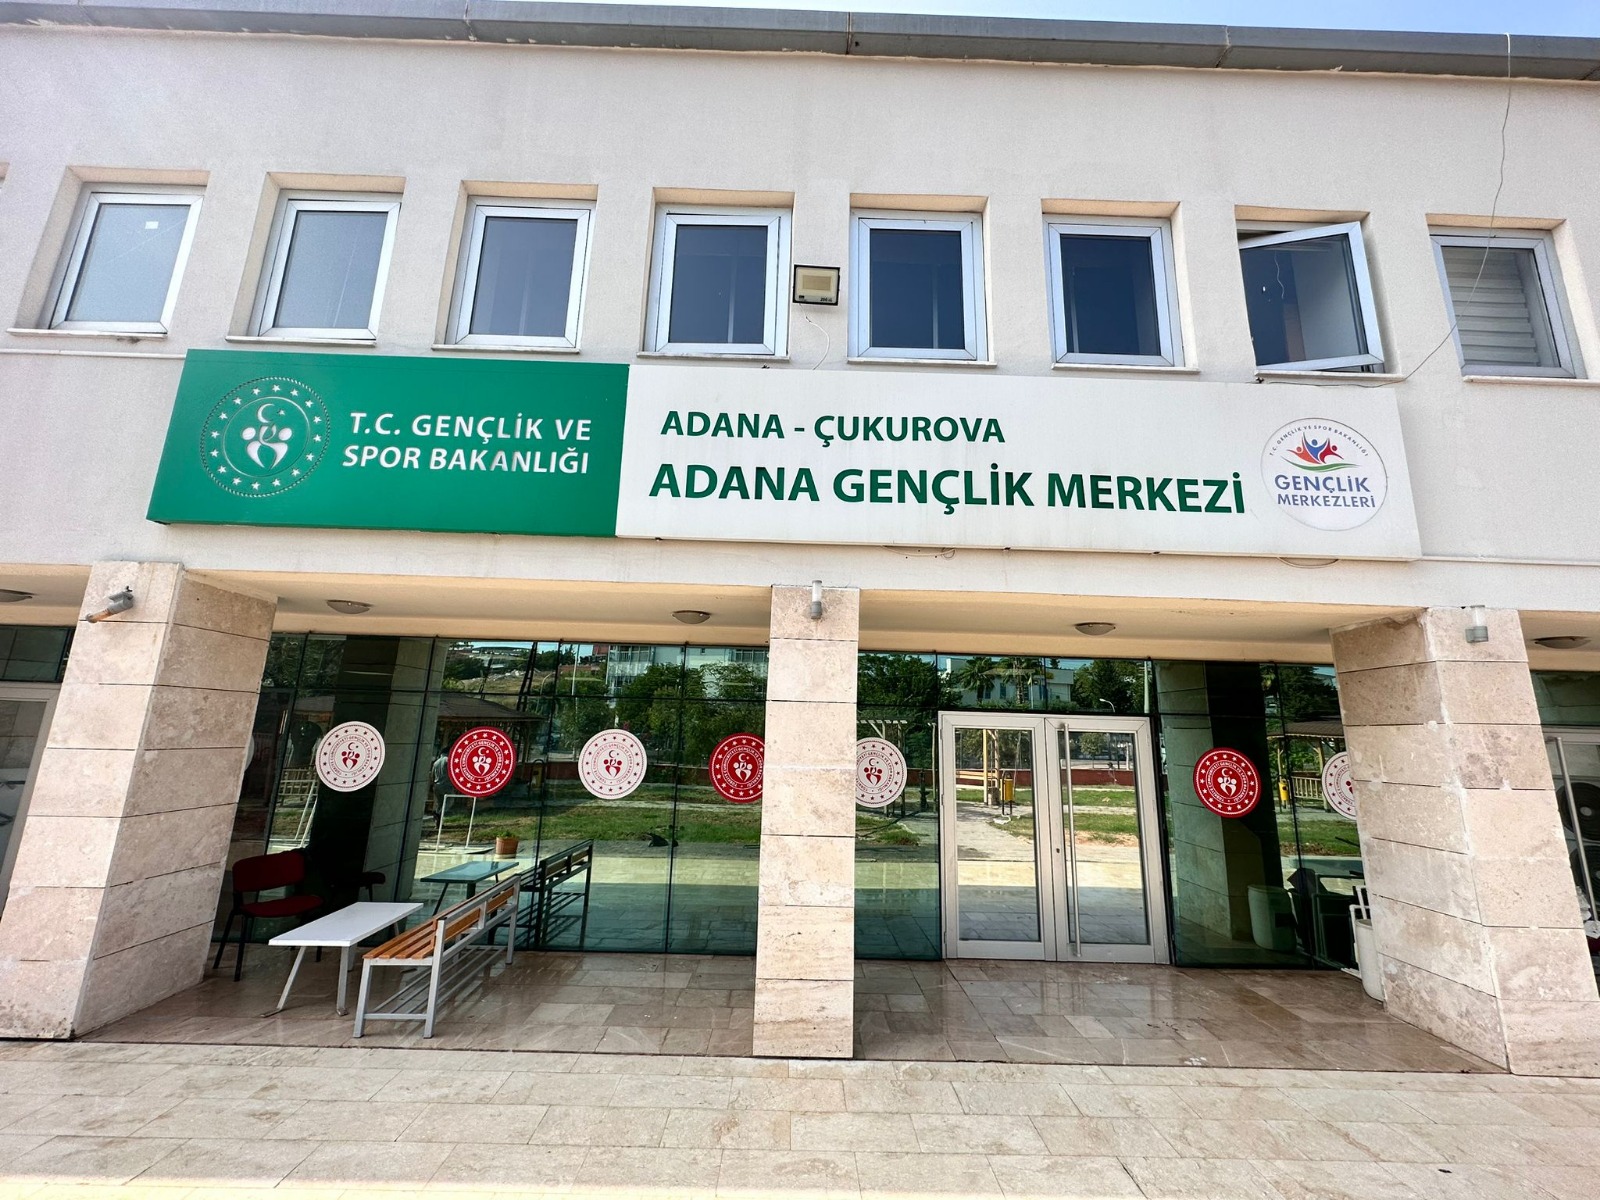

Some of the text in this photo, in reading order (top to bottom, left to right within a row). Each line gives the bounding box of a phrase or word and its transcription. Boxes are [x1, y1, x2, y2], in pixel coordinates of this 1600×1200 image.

[350, 412, 592, 444] T.C. GENÇLİK VE
[660, 410, 785, 439] ADANA
[813, 415, 1006, 448] ÇUKUROVA
[342, 445, 589, 474] SPOR BAKANLIĞI
[648, 463, 1246, 515] ADANA GENÇLİK MERKEZİ
[1274, 474, 1371, 493] GENÇLİK
[1277, 493, 1376, 508] MERKEZLERİ
